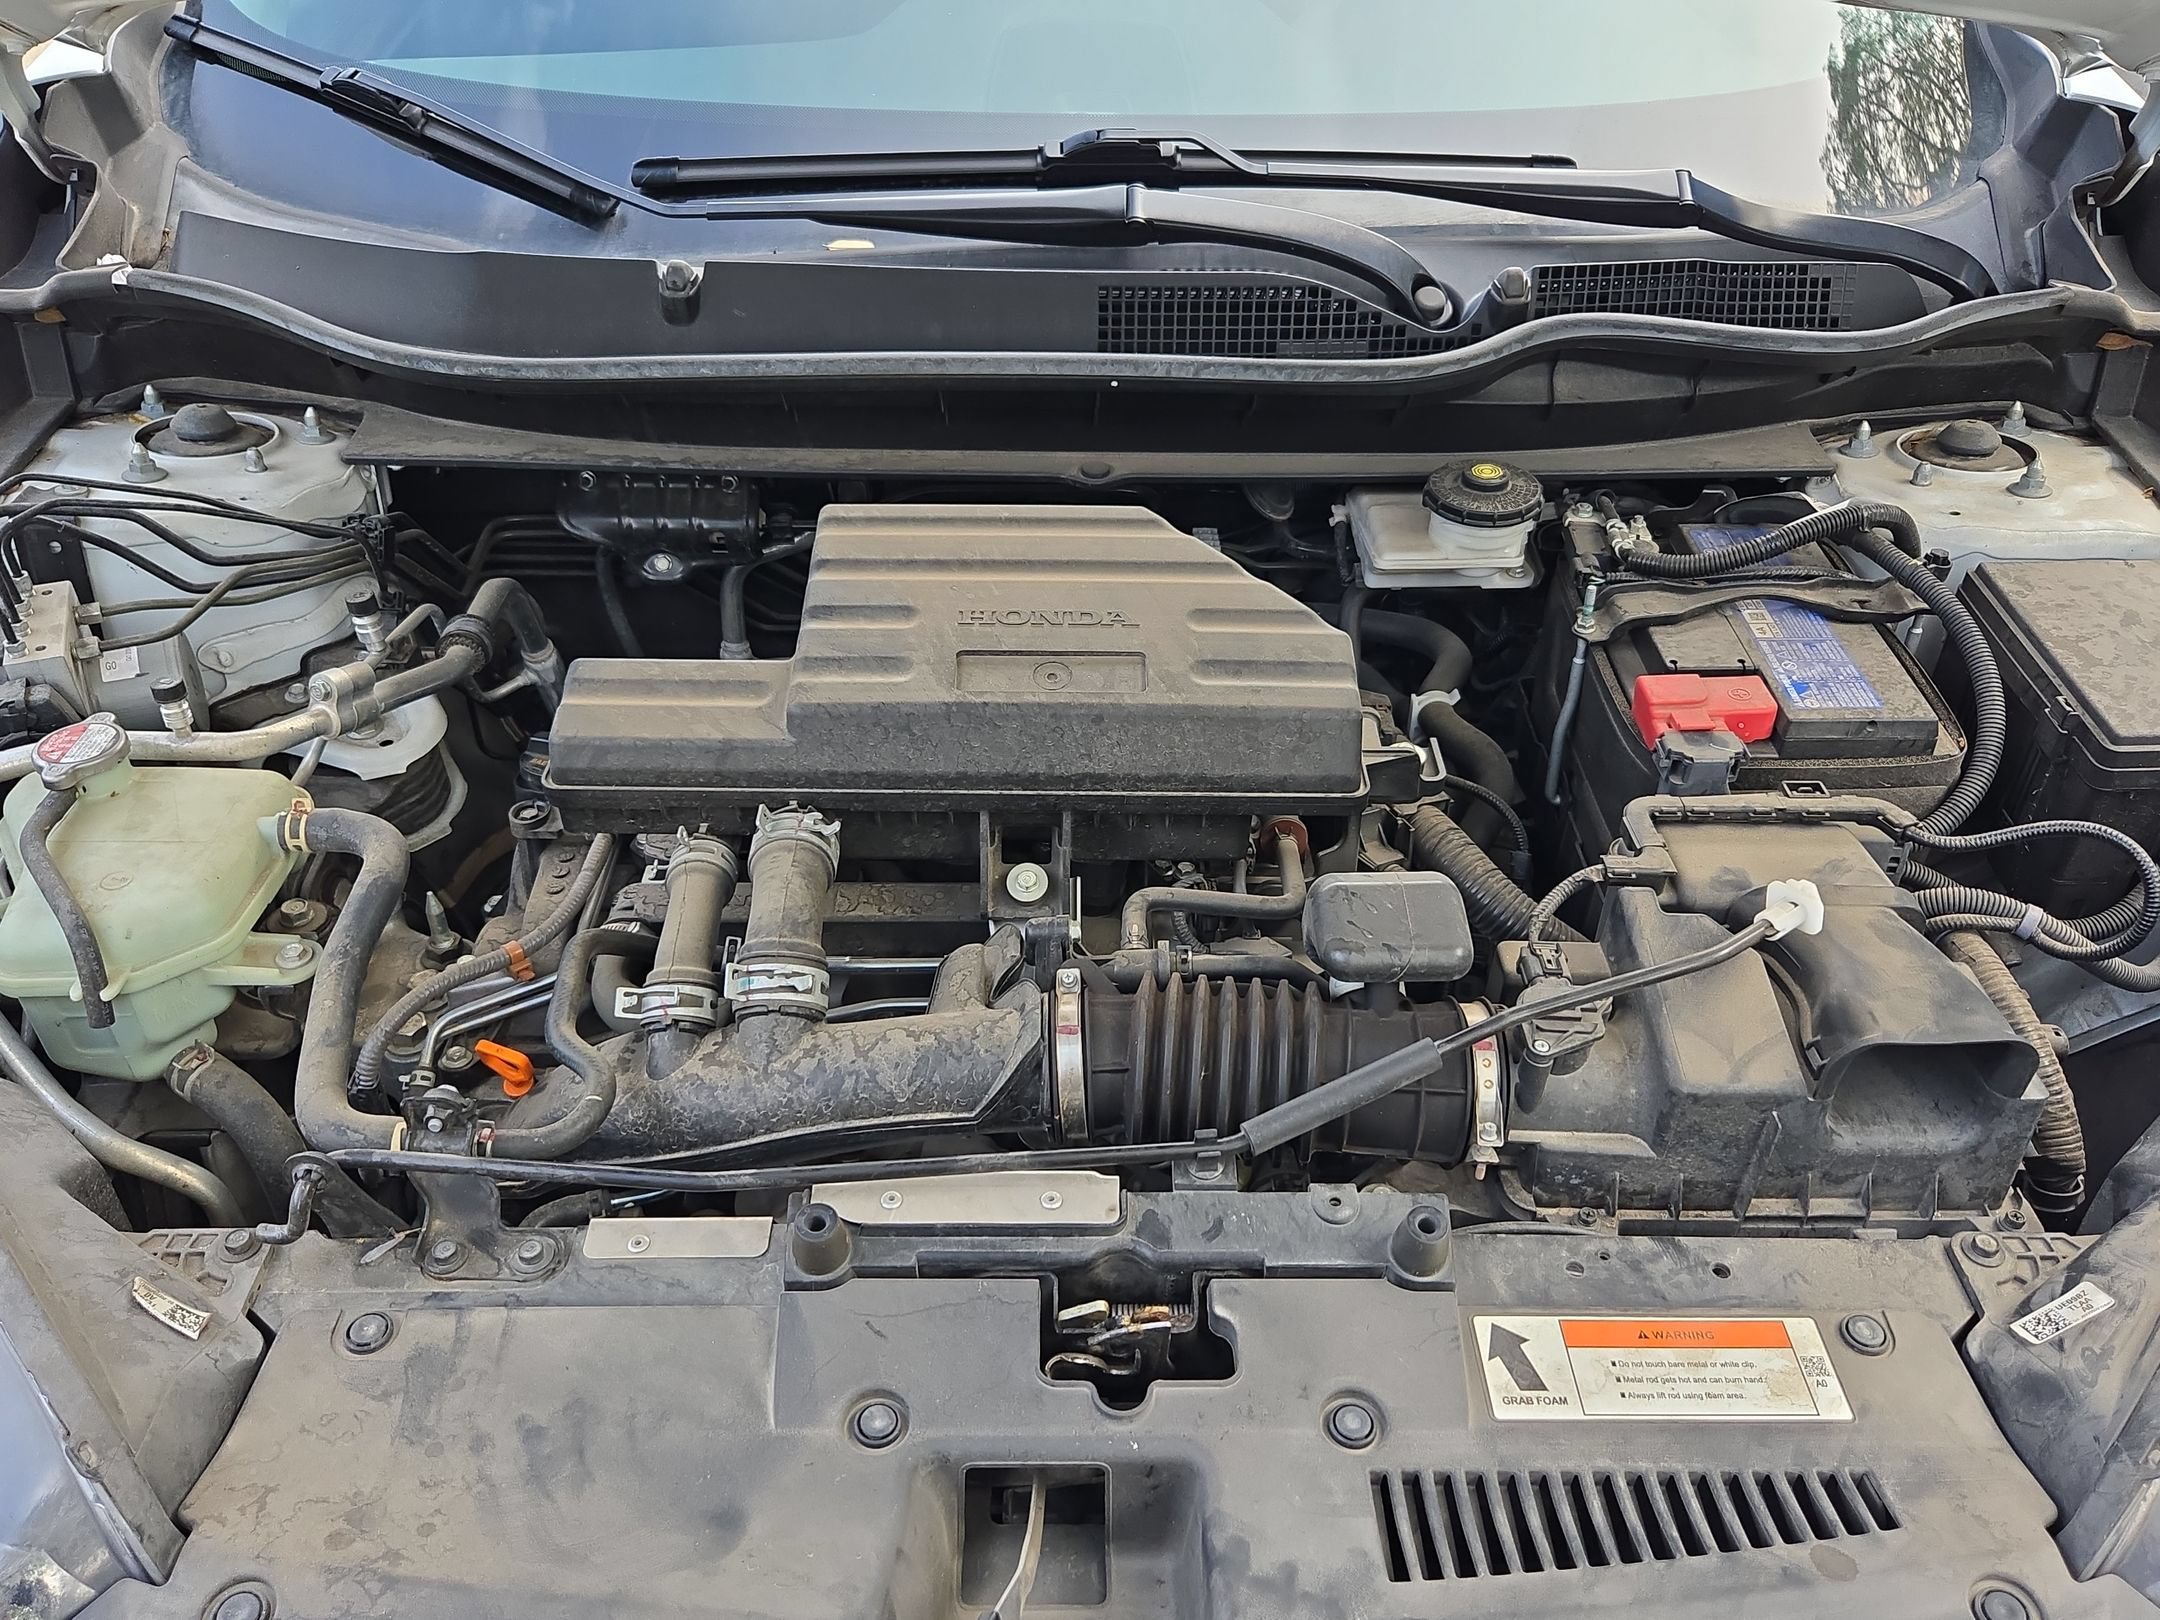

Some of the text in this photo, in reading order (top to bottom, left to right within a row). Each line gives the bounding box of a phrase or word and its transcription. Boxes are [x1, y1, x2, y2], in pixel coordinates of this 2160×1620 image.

[957, 609, 1141, 627] HONDA
[1651, 1330, 1715, 1340] WARNING
[1617, 1360, 1630, 1368] Do
[1631, 1360, 1644, 1368] not
[1644, 1360, 1667, 1368] touch
[1667, 1360, 1686, 1368] bare
[1719, 1360, 1740, 1368] white
[1741, 1360, 1758, 1369] clip.
[1622, 1376, 1644, 1384] Metal
[1645, 1376, 1659, 1384] rod
[1660, 1376, 1677, 1385] gets
[1677, 1376, 1691, 1384] hot
[1692, 1376, 1708, 1384] and
[1724, 1376, 1743, 1384] burn
[1502, 1396, 1569, 1406] GRAB FOAM
[1627, 1391, 1656, 1401] Always
[1656, 1391, 1667, 1399] lift
[1667, 1391, 1681, 1399] rod
[1682, 1391, 1704, 1400] using
[1704, 1391, 1725, 1400] foam
